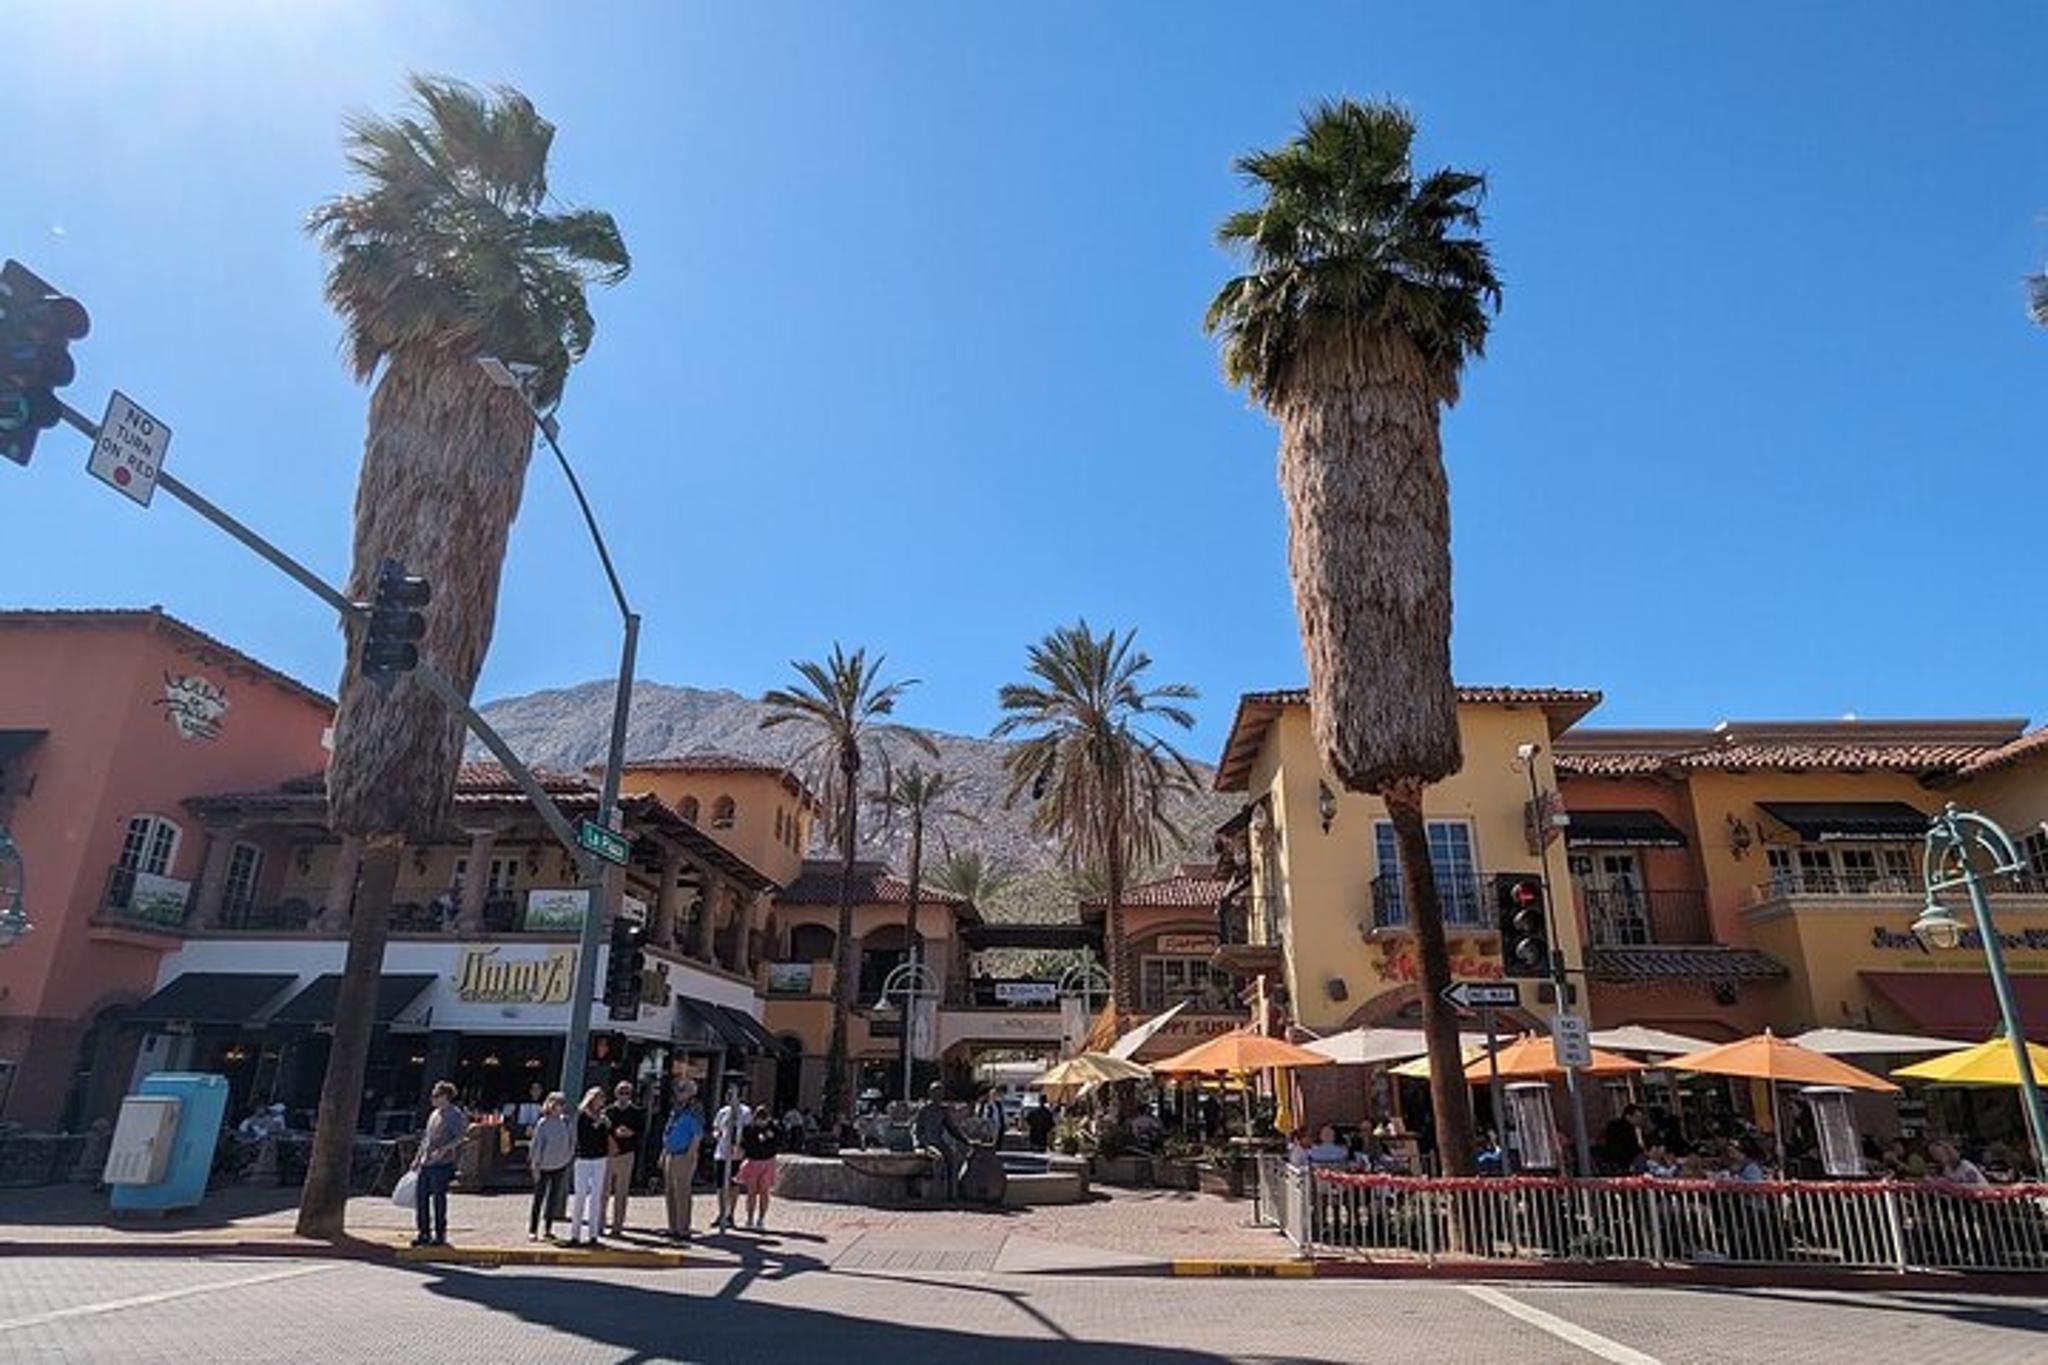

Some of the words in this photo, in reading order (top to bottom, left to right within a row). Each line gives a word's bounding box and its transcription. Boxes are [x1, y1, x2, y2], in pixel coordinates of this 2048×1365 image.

[126, 408, 154, 437] NO
[117, 424, 152, 458] TURN
[102, 437, 123, 458] ON
[128, 453, 155, 479] RED
[1488, 989, 1512, 1000] WAY
